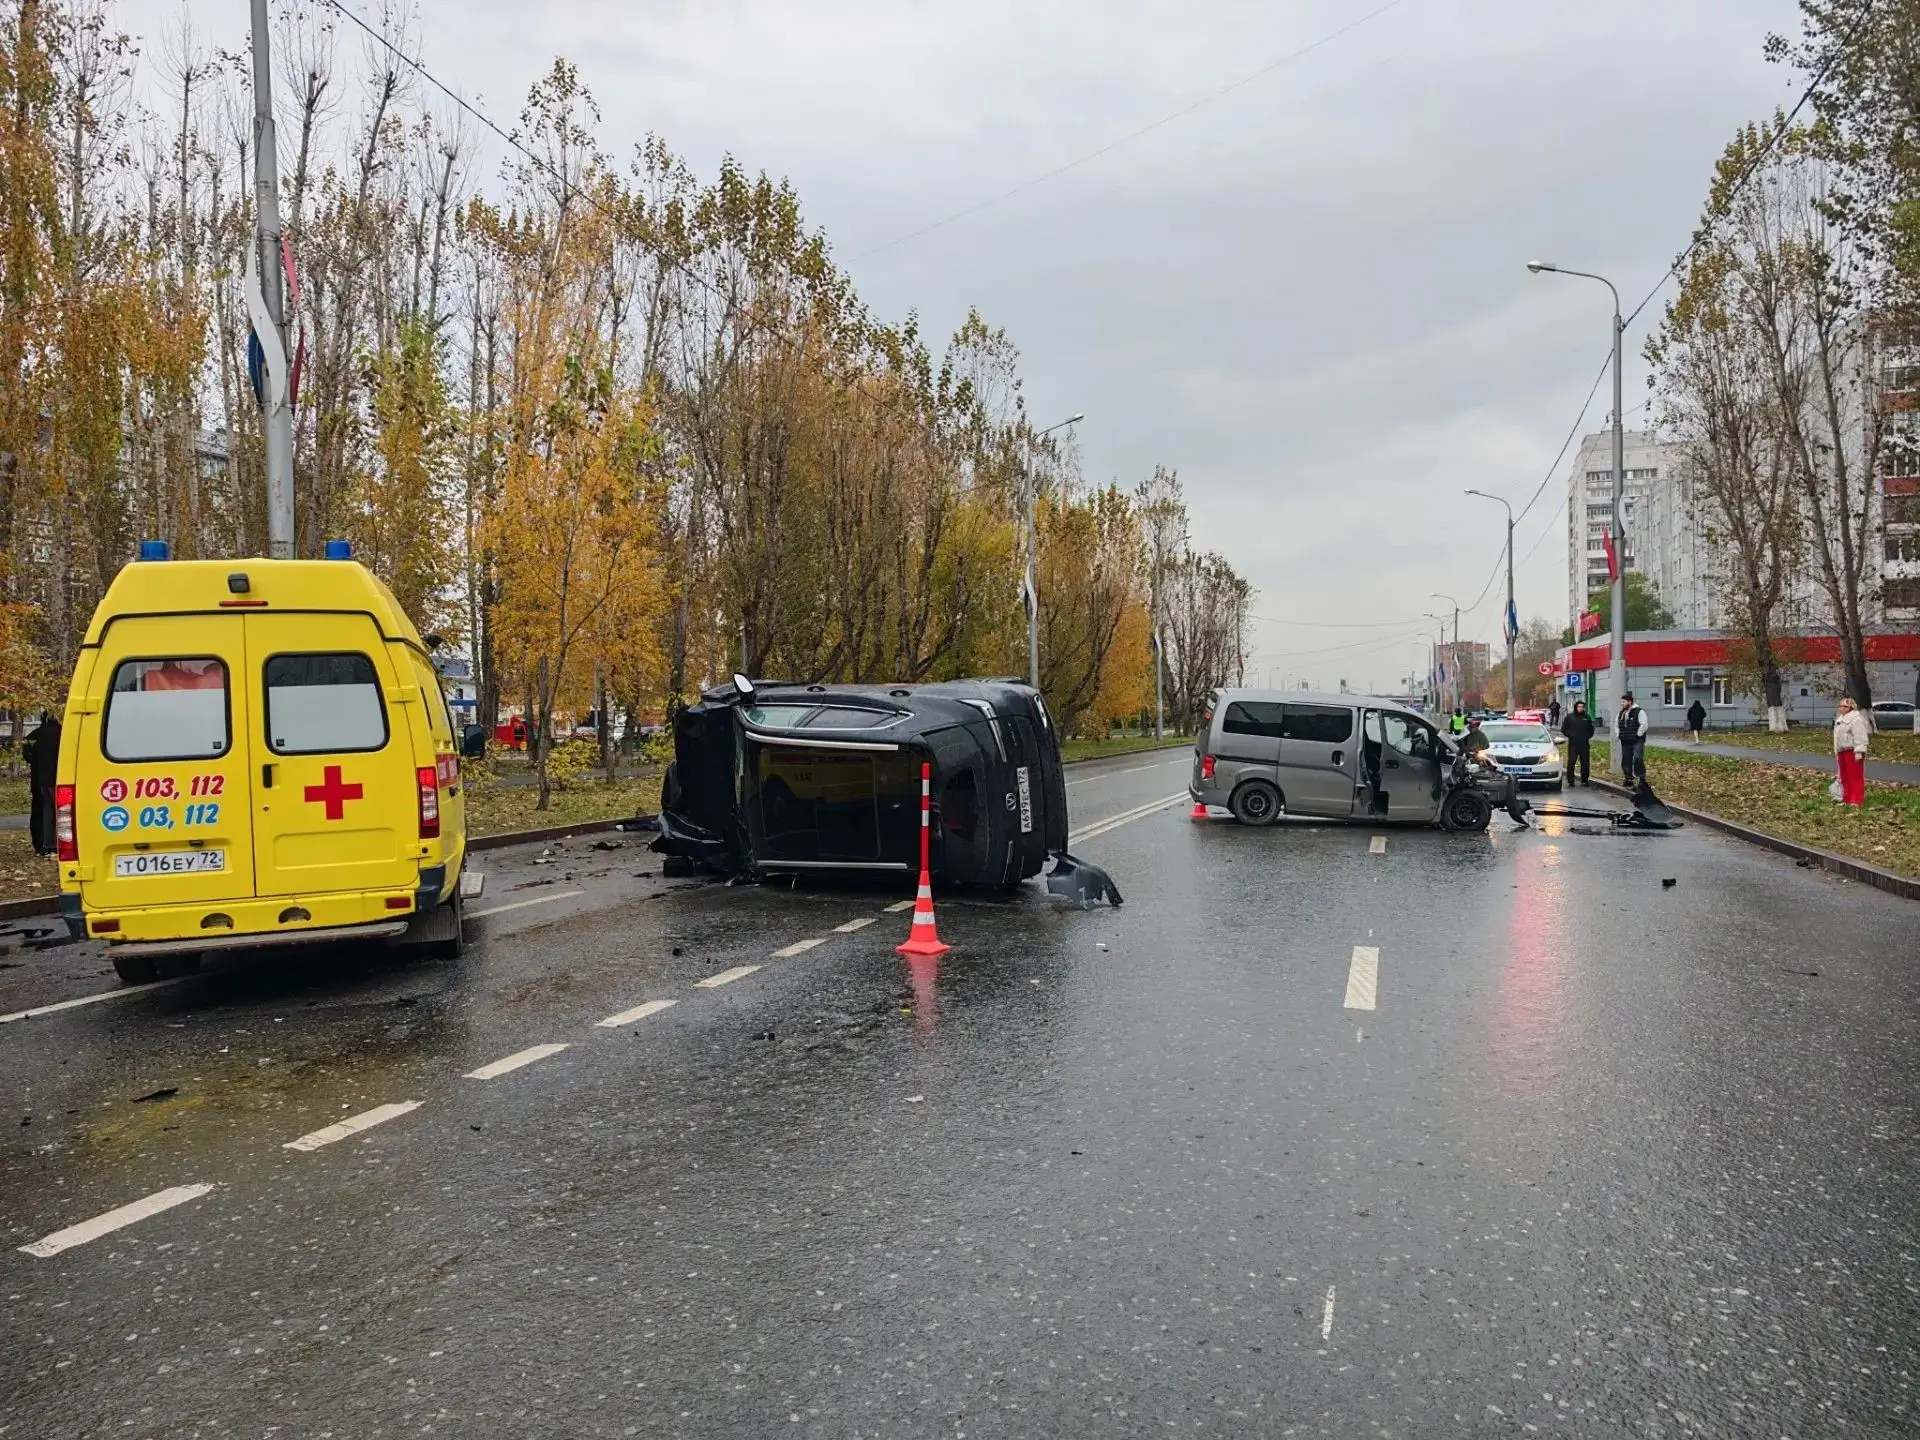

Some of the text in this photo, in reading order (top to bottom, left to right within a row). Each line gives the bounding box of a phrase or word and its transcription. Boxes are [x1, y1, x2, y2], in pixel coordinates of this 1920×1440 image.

[1570, 675, 1579, 685] P
[134, 775, 225, 801] 103, 112
[139, 803, 220, 829] 03, 112
[123, 851, 218, 873] Т016ЕУ 72
